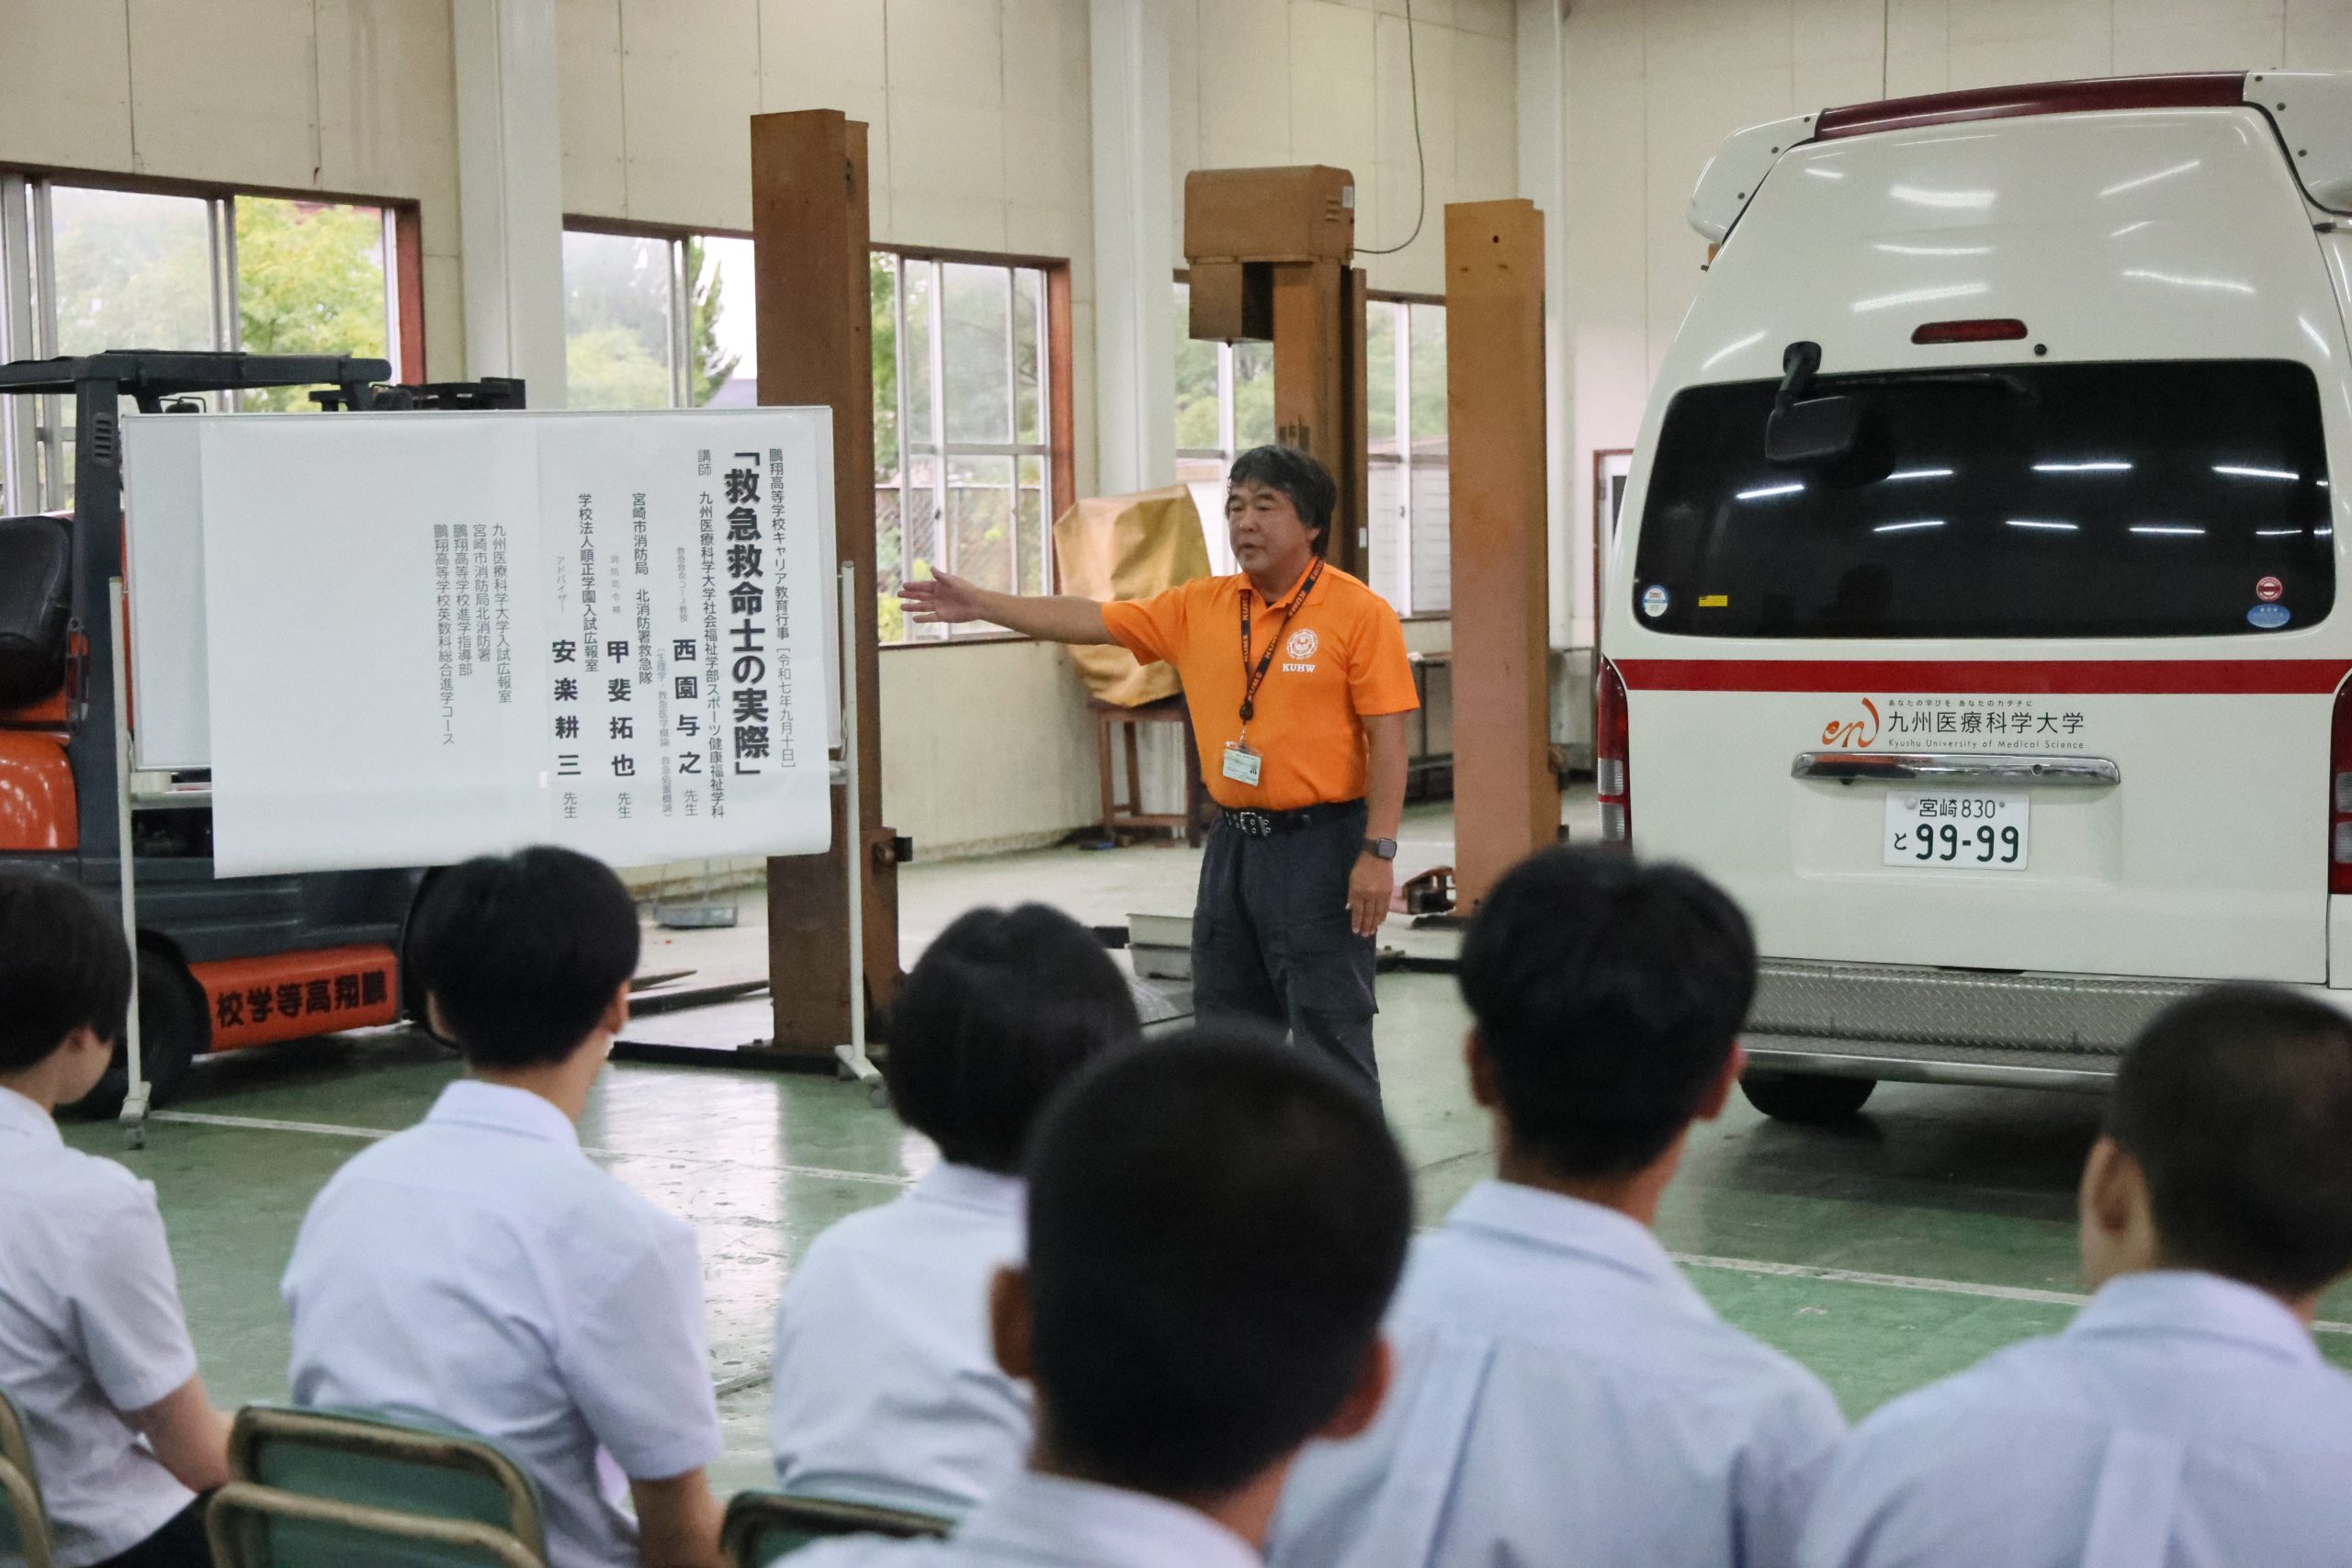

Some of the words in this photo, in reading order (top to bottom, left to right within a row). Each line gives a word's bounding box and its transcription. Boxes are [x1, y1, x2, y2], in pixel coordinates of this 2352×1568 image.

[697, 448, 712, 477] 講師
[631, 491, 649, 576] 宮崎市消防局
[472, 523, 492, 663] 宮崎市消防局北消防署
[577, 491, 600, 673] 学校法人順正学園入試広報室
[492, 523, 513, 705] 九州医療科学大学入試広報室
[723, 451, 770, 776] 「救急救命士の実際」
[635, 589, 653, 685] 北消防署救急隊
[1282, 662, 1317, 674] KUHW
[1888, 699, 1951, 707] あなたの学びを
[1959, 699, 2033, 708] あなたのカタチに
[1887, 711, 2085, 735] 九州医療科学大学
[1888, 739, 1922, 750] Kyushu
[1926, 739, 1976, 750] University
[1982, 739, 1993, 749] of
[1997, 739, 2040, 750] Medical
[2044, 739, 2085, 750] Science
[562, 791, 578, 819] 先生
[616, 791, 632, 819] 先生
[684, 788, 698, 818] 先生
